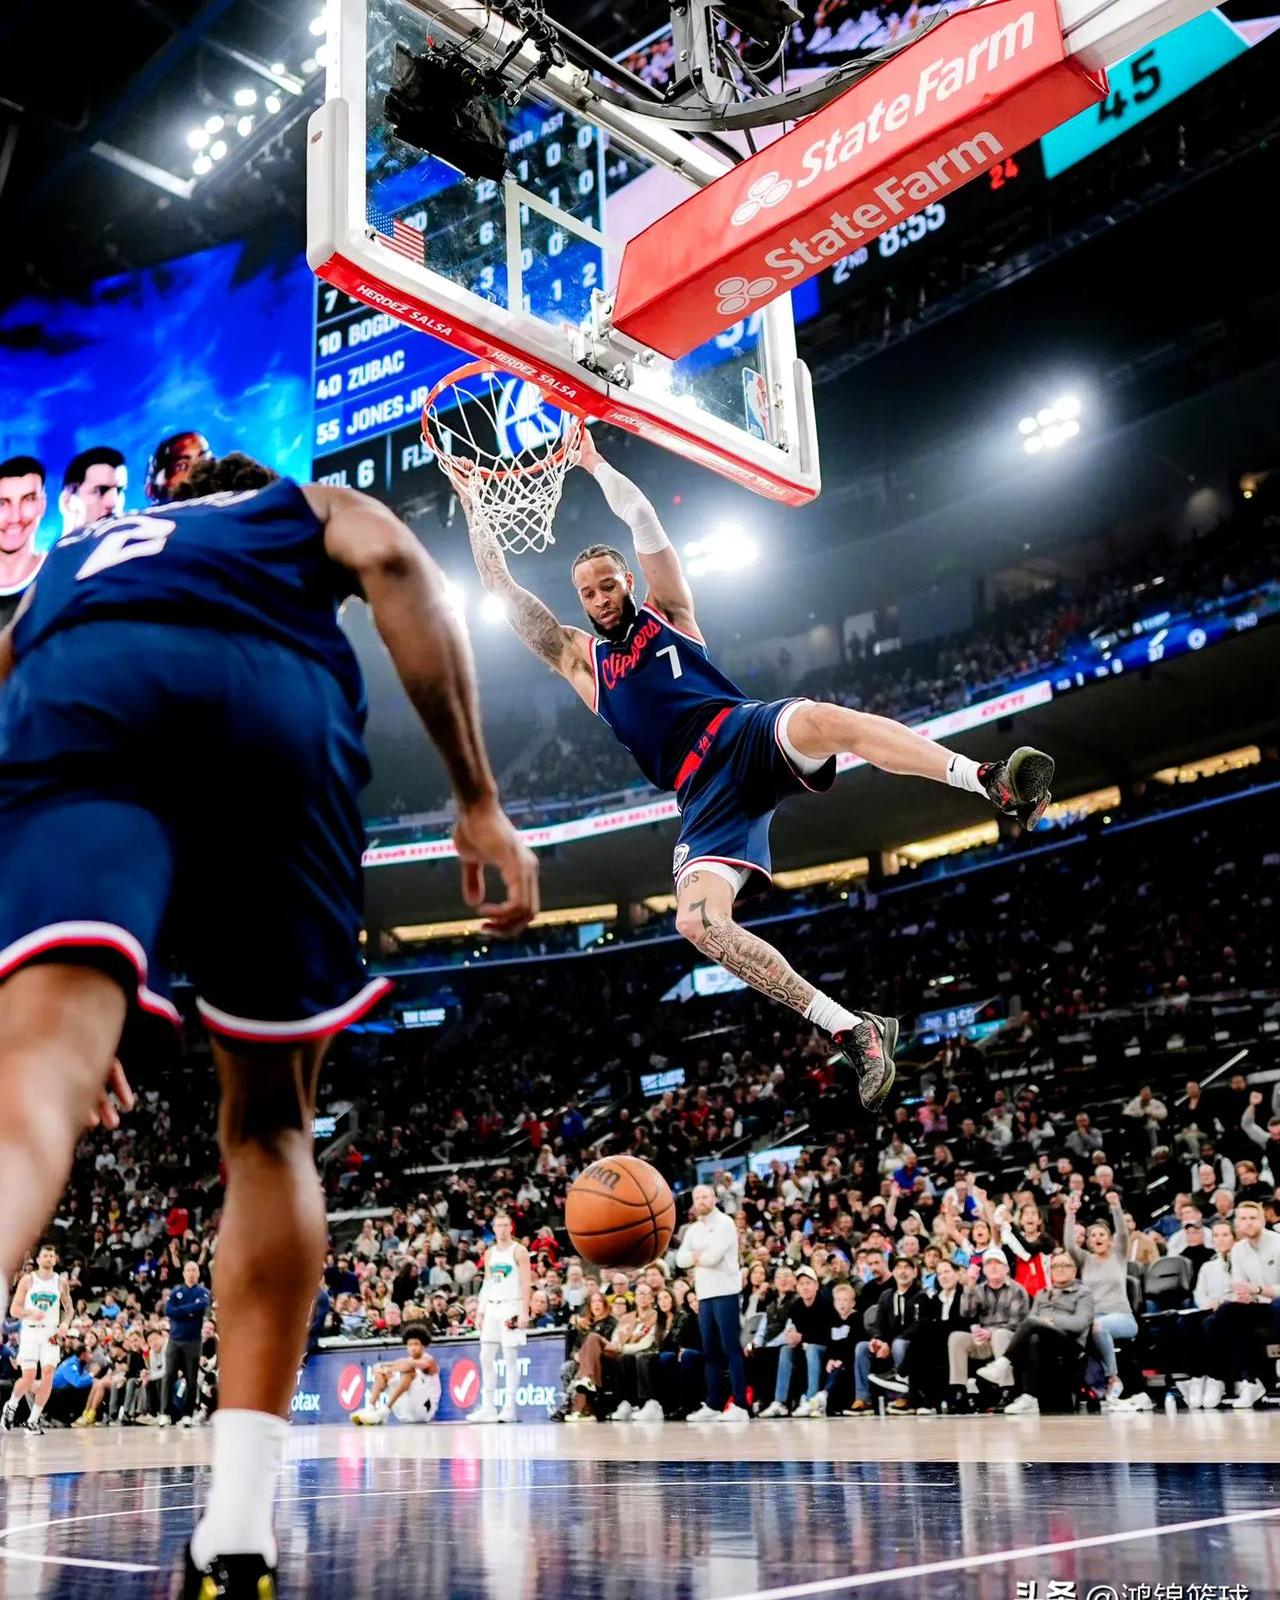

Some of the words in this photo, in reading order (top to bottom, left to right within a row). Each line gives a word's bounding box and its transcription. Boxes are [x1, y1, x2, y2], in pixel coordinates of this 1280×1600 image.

[1099, 48, 1161, 123] 45
[879, 203, 945, 257] 8:55
[582, 262, 597, 289] 2
[357, 284, 410, 314] HERDEZ
[408, 311, 453, 336] SALSA
[318, 330, 342, 357] 10
[316, 374, 342, 400] 40
[347, 350, 405, 391] ZUBAC
[490, 351, 539, 378] HERDEZ
[536, 373, 578, 399] SALSA
[316, 419, 340, 445] 55
[346, 395, 404, 435] JONES
[357, 459, 375, 489] 6
[602, 618, 662, 690] Clippers
[656, 645, 683, 680] 7
